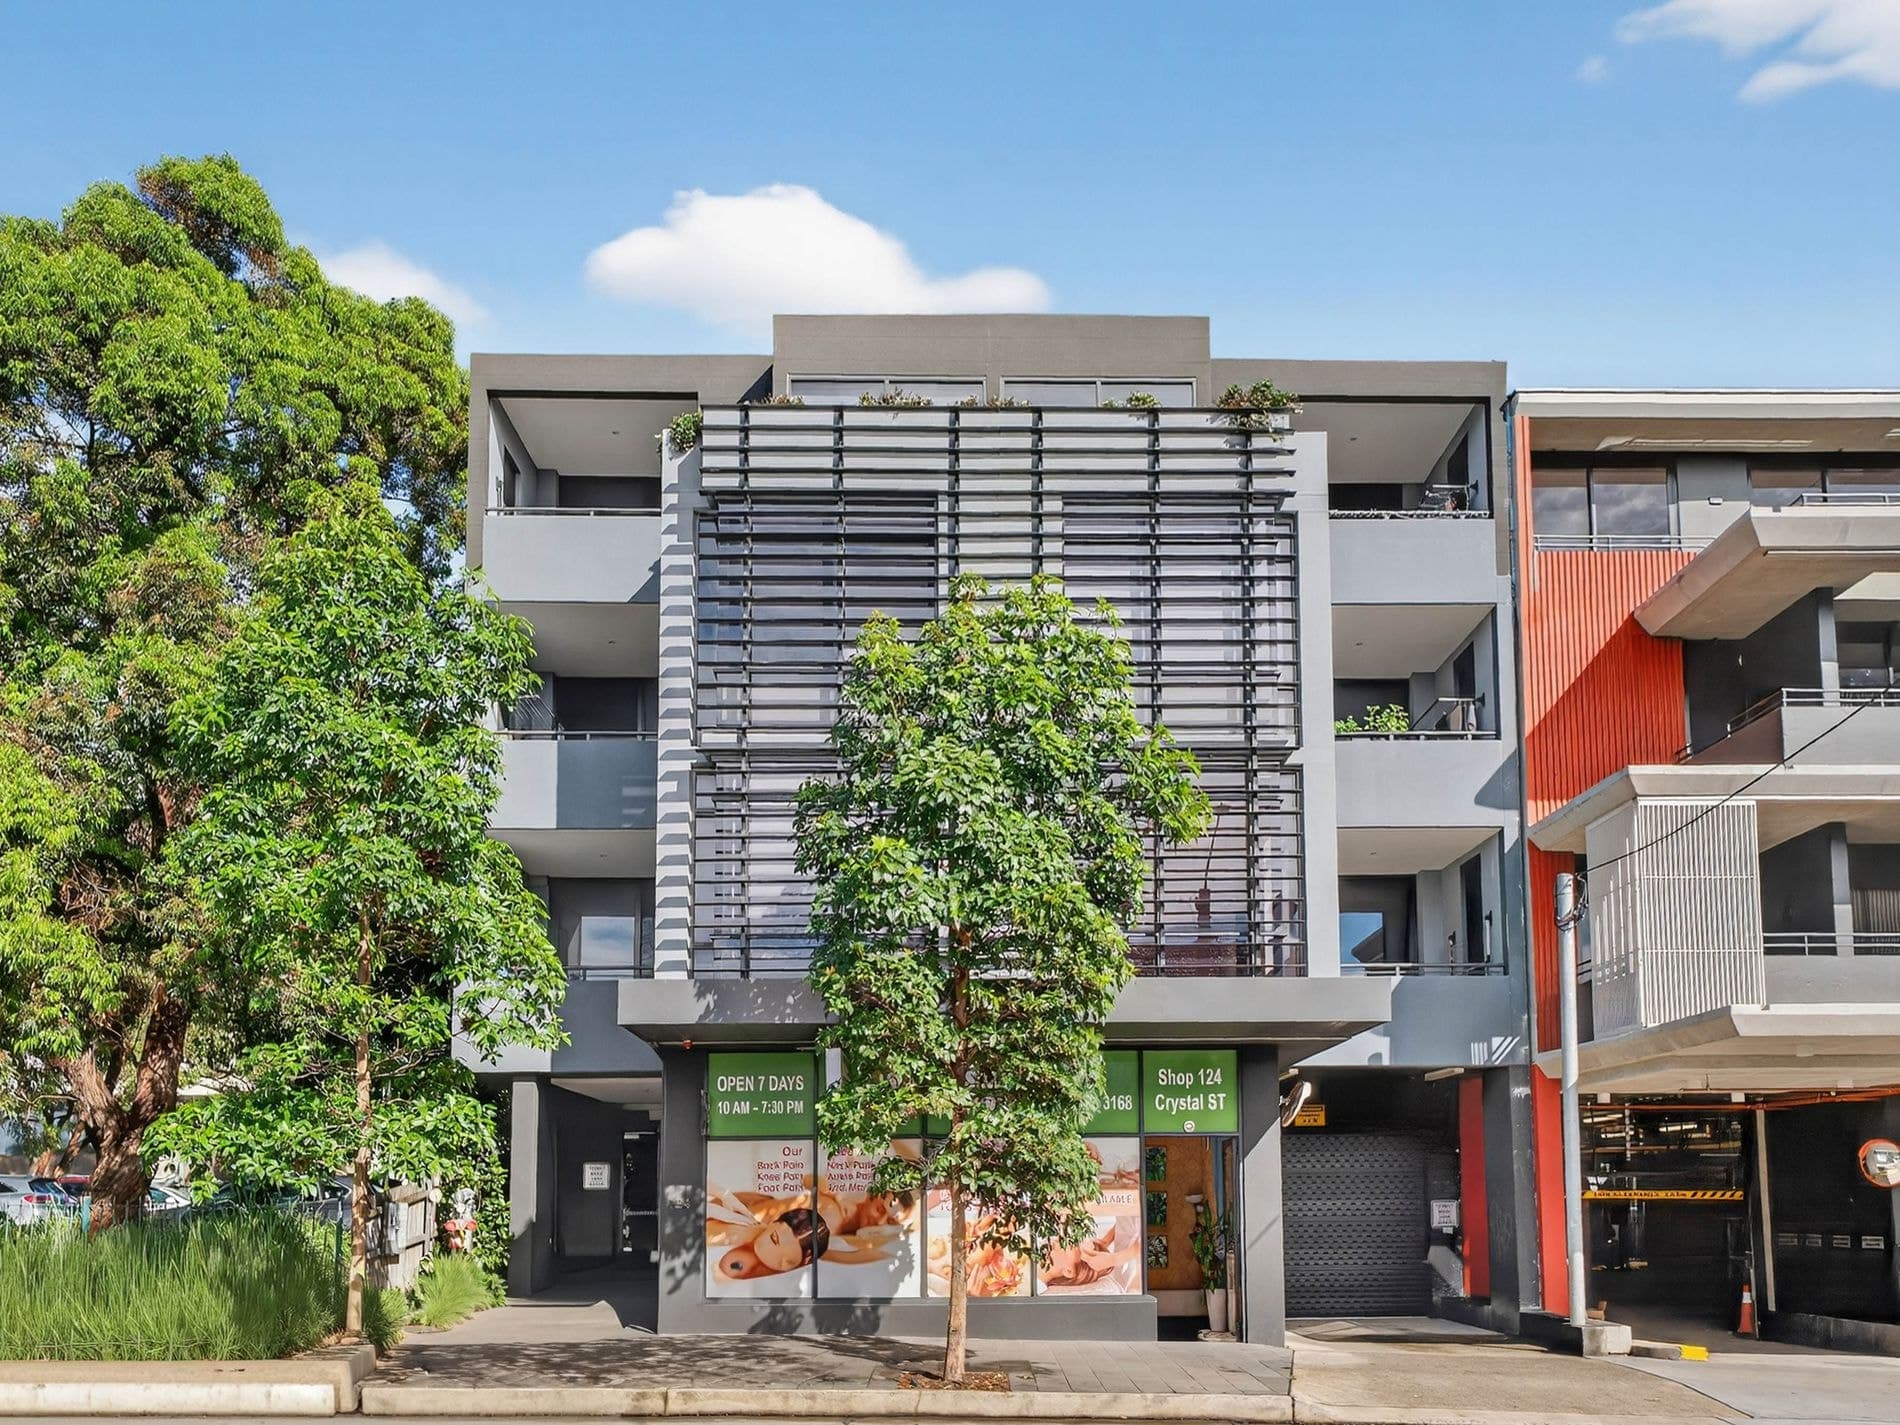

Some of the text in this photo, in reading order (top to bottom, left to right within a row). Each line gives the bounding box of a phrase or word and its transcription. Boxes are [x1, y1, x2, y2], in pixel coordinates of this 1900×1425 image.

[717, 1075, 804, 1092] OPEN 7 DAYS
[1158, 1068, 1223, 1089] Shop 124
[718, 1101, 730, 1114] 10
[732, 1101, 750, 1114] AM
[761, 1101, 784, 1114] 7:30
[786, 1100, 804, 1114] PM
[1103, 1095, 1133, 1110] 3168
[1155, 1093, 1226, 1115] Crystal ST
[782, 1146, 803, 1156] Our
[783, 1160, 804, 1170] Pain
